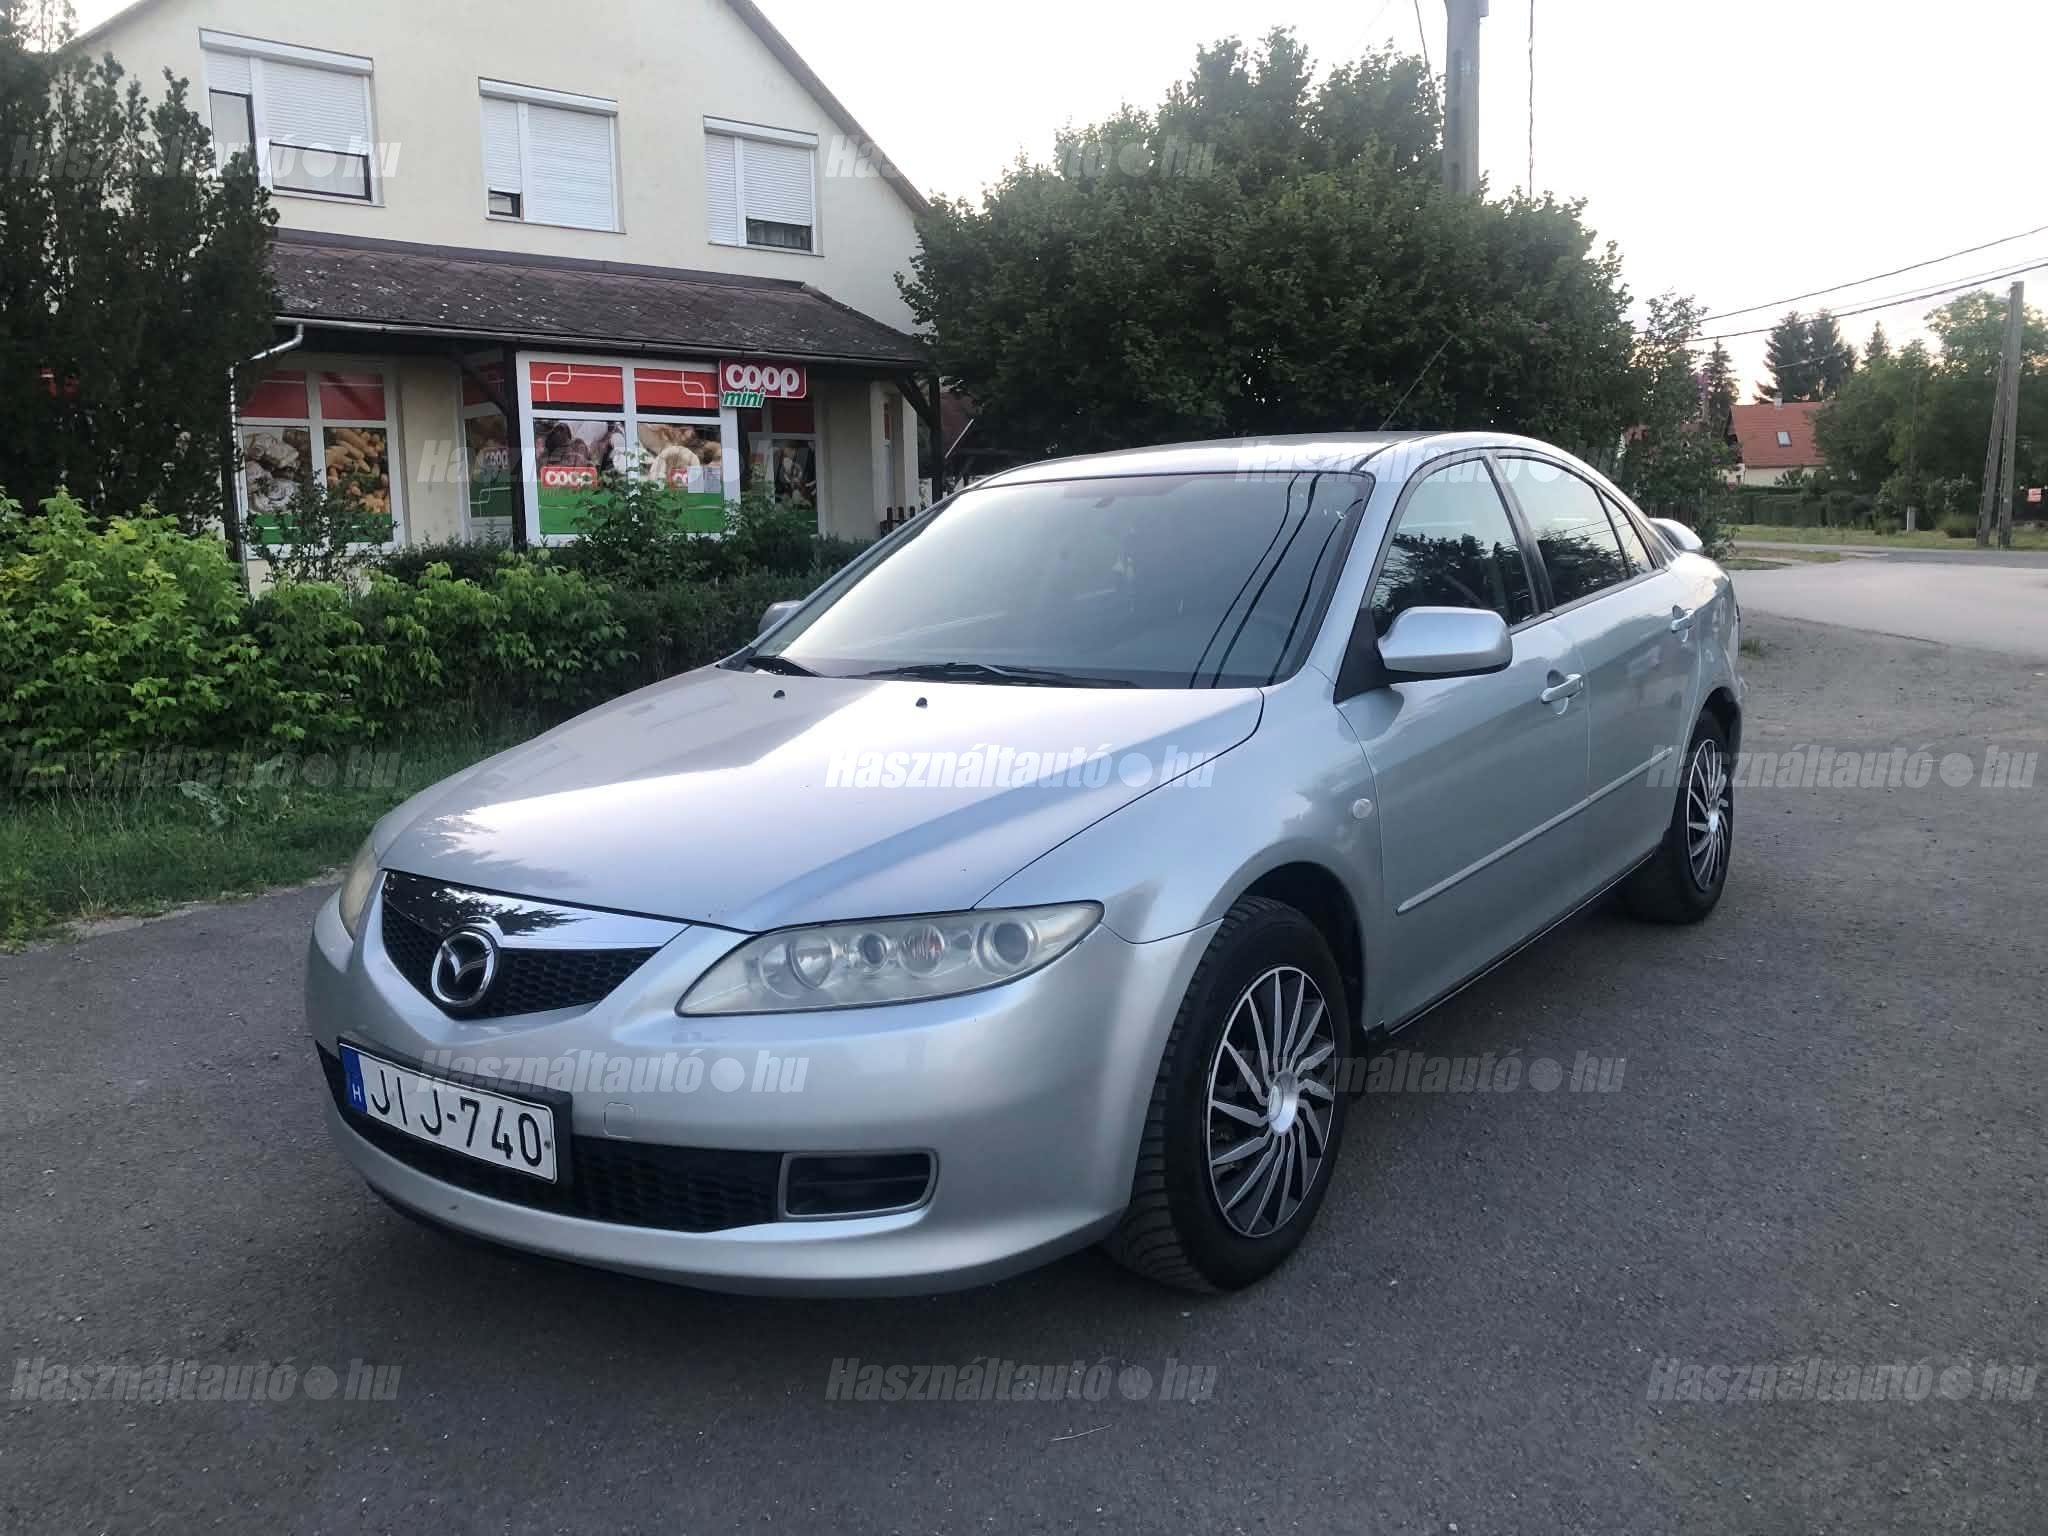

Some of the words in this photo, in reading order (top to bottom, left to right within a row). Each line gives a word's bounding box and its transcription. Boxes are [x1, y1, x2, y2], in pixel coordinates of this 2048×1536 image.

[723, 385, 766, 407] mini
[351, 1082, 362, 1103] H
[371, 1069, 542, 1167] JIJ-740
